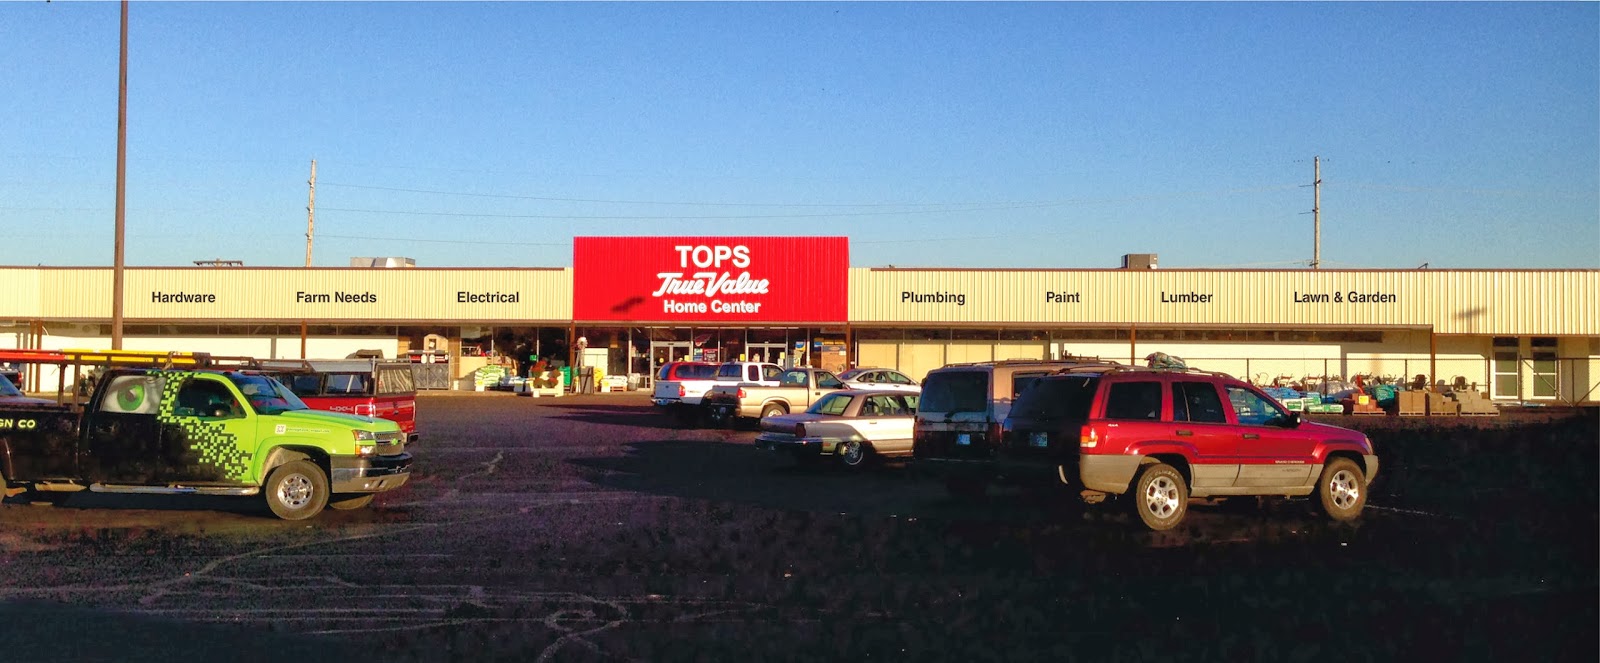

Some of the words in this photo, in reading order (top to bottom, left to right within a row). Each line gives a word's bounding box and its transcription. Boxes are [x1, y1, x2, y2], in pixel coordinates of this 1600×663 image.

[674, 245, 751, 268] TOPS
[652, 272, 705, 297] True
[693, 271, 769, 297] Value
[152, 291, 216, 303] Hardware
[296, 291, 330, 303] Farm
[335, 291, 377, 303] Needs
[457, 291, 519, 303] Electrical
[901, 291, 966, 306] Plumbing
[1046, 291, 1080, 303] Paint
[1161, 291, 1214, 303] Lumber
[1294, 291, 1329, 303] Lawn
[1334, 291, 1343, 303] &
[1348, 291, 1396, 303] Garden
[663, 299, 707, 313] Home
[711, 299, 761, 313] Center
[18, 419, 36, 428] CO
